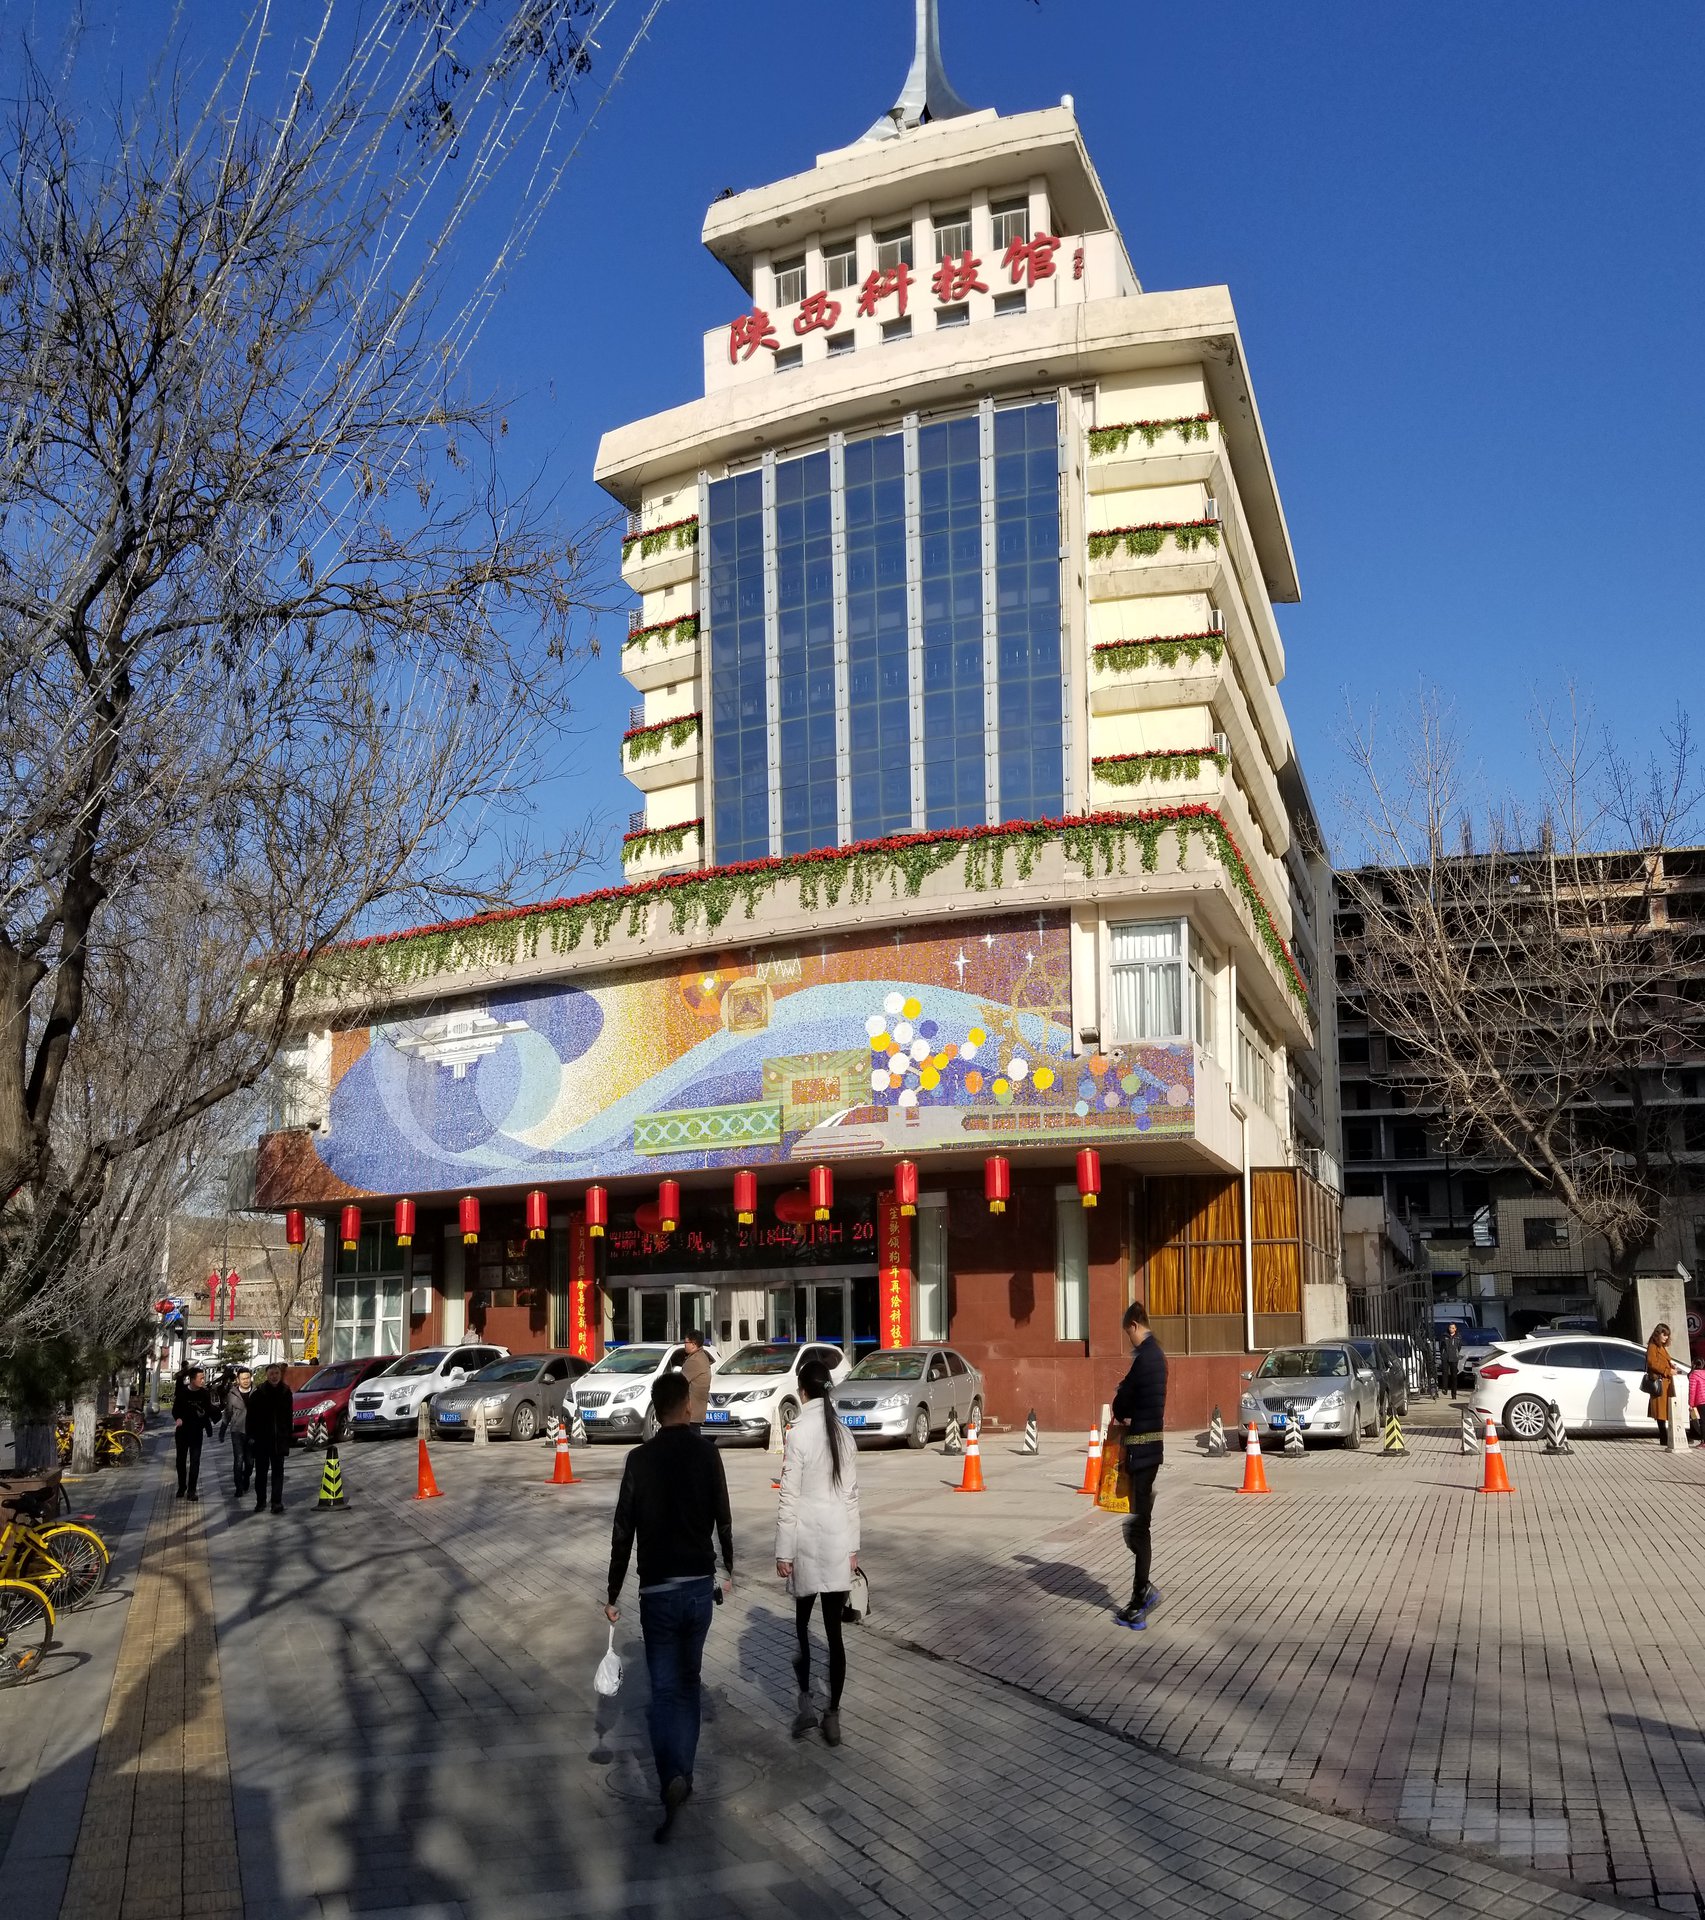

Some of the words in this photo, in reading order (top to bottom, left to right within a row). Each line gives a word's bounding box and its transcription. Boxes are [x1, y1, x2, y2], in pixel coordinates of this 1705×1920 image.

[728, 232, 1061, 364] 陕西科技馆
